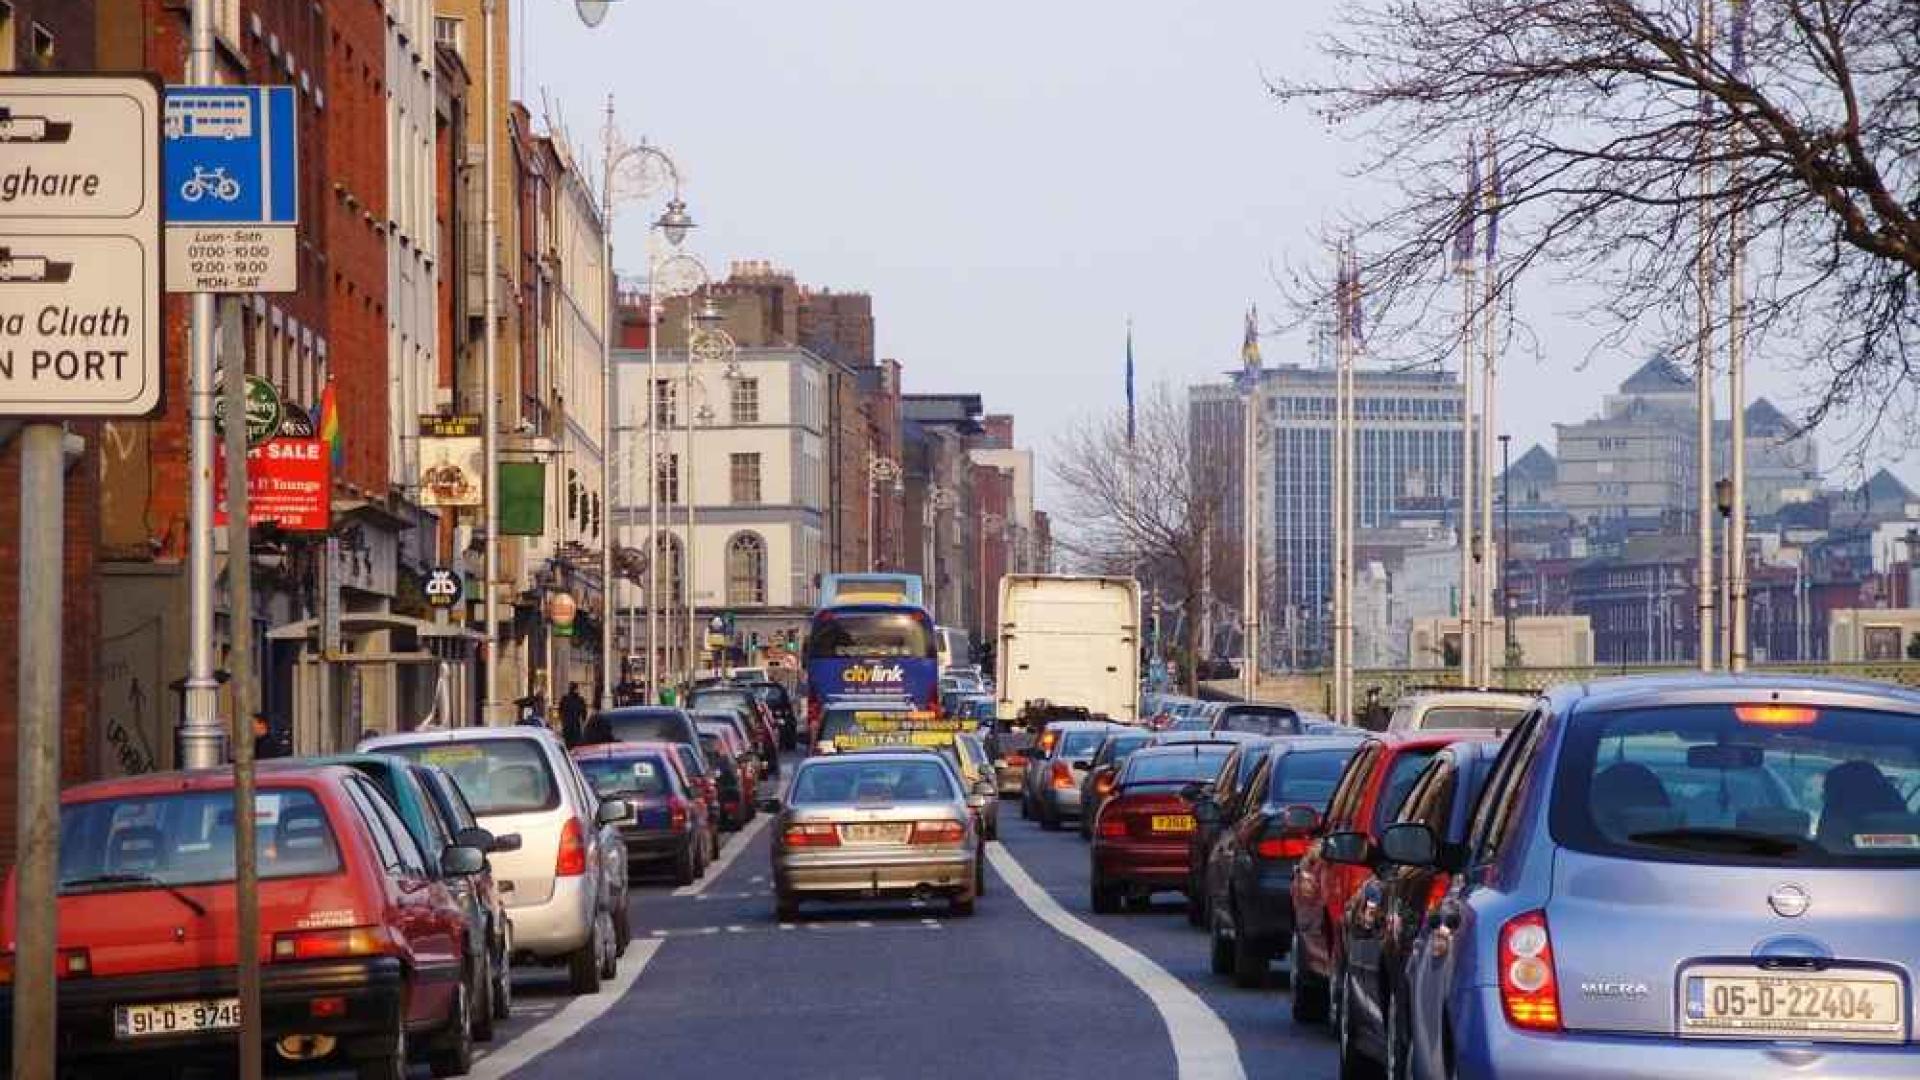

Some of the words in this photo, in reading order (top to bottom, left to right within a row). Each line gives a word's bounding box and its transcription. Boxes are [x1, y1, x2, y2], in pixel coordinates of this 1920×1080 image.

[237, 276, 260, 287] SAT
[38, 305, 129, 336] Cliath
[32, 350, 128, 380] PORT
[268, 443, 320, 459] SALE
[843, 664, 905, 685] citylink
[1581, 982, 1649, 998] MICRA
[1713, 984, 1875, 1020] 05-D-22404
